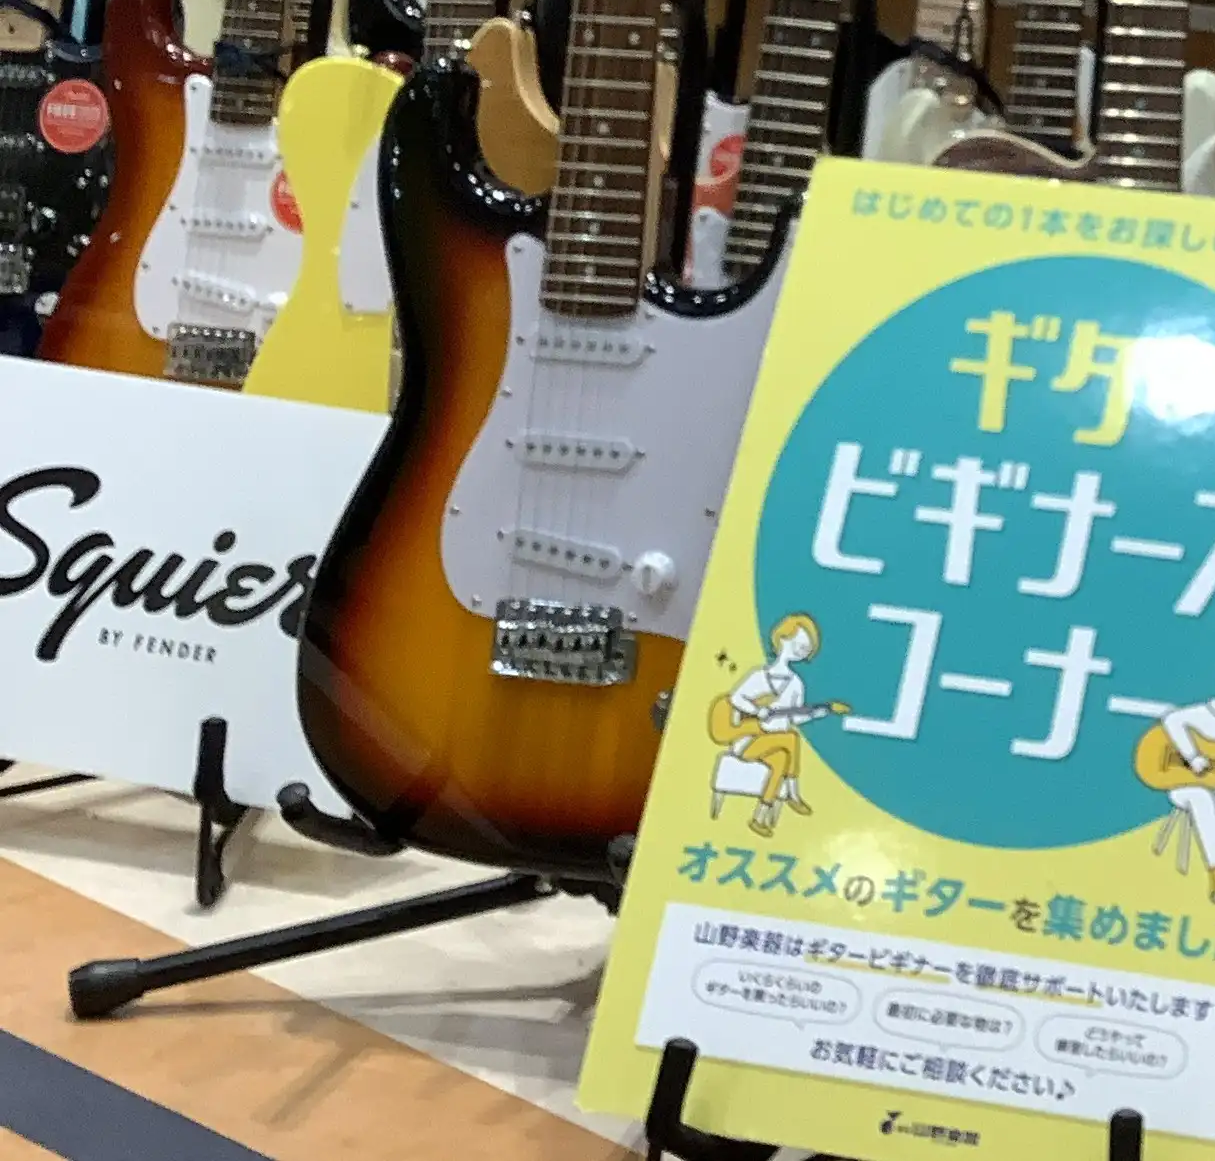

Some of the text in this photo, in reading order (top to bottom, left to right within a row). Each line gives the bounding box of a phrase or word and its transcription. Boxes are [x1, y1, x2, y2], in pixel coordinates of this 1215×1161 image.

[949, 310, 1200, 448] ギタ
[0, 465, 318, 664] Squier
[98, 627, 219, 665] BY FENDER
[841, 602, 1178, 761] コーナー
